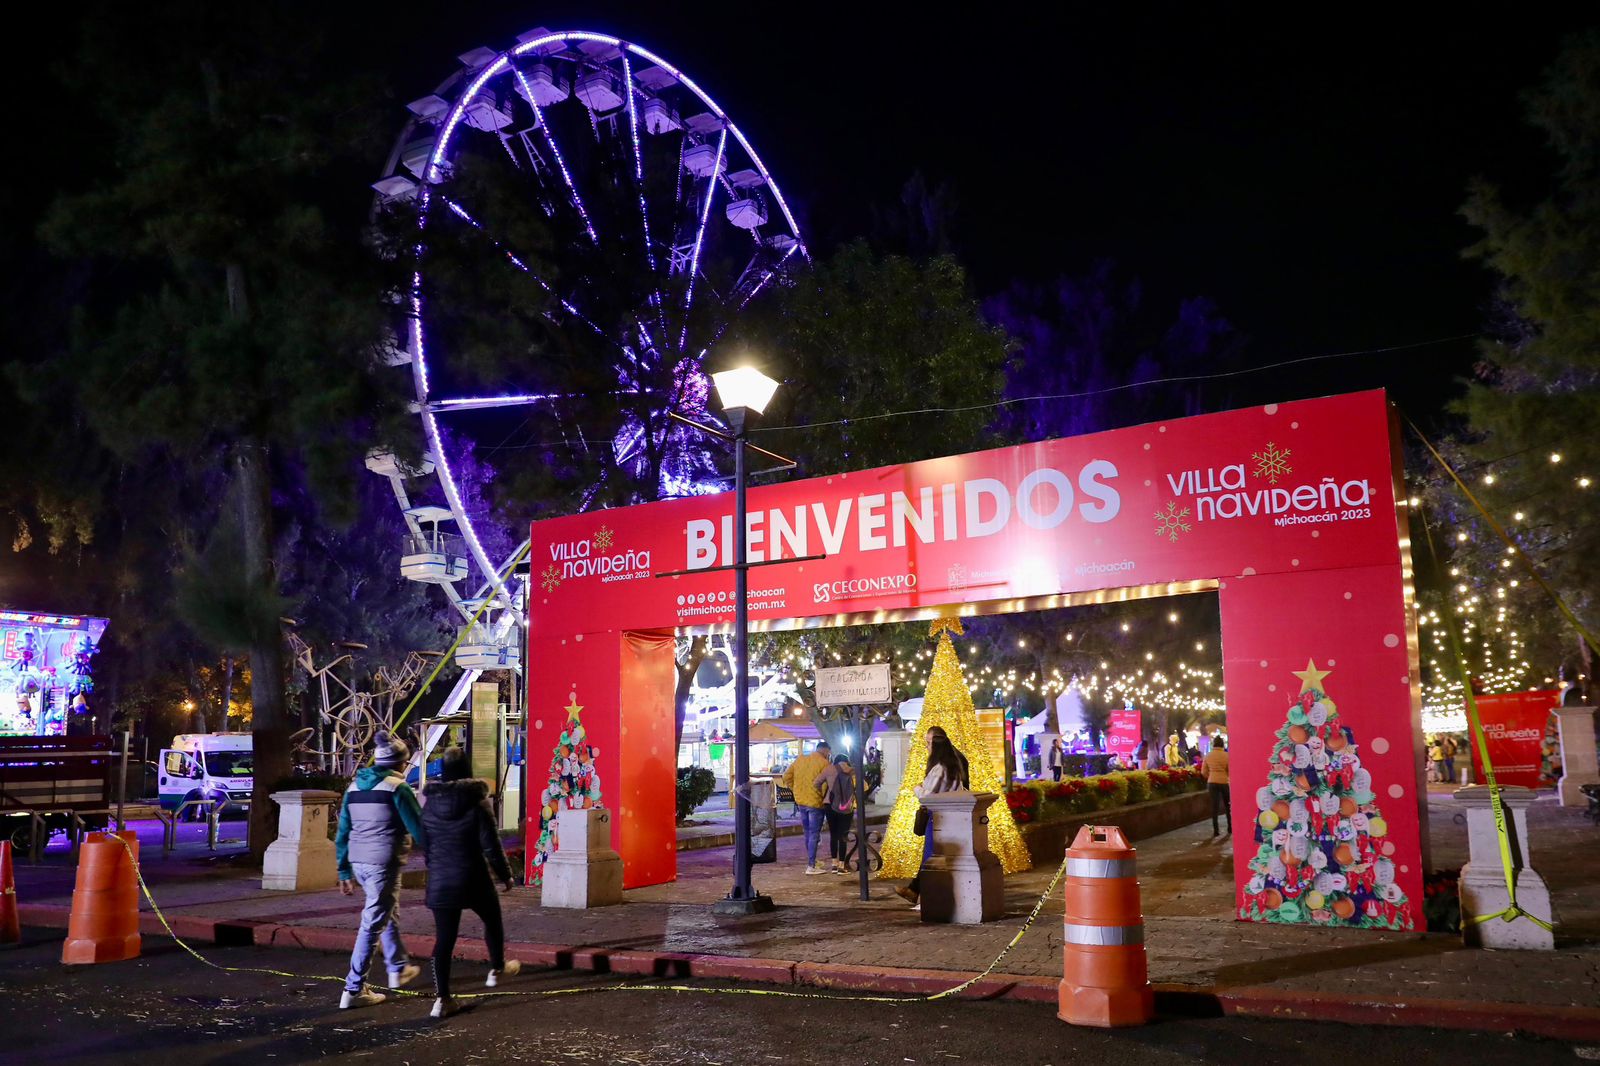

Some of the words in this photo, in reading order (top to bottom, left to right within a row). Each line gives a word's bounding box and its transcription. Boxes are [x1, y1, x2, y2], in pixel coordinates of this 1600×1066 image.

[687, 459, 1121, 570] BIENVENIDOS
[1274, 510, 1338, 528] Michoacán
[1340, 507, 1372, 521] 2023
[634, 570, 651, 579] 2023
[831, 573, 918, 595] CECONEXPO
[728, 587, 785, 601] @choacan
[676, 600, 786, 617] visitmichoaccom.mx
[830, 671, 873, 684] CALZADA
